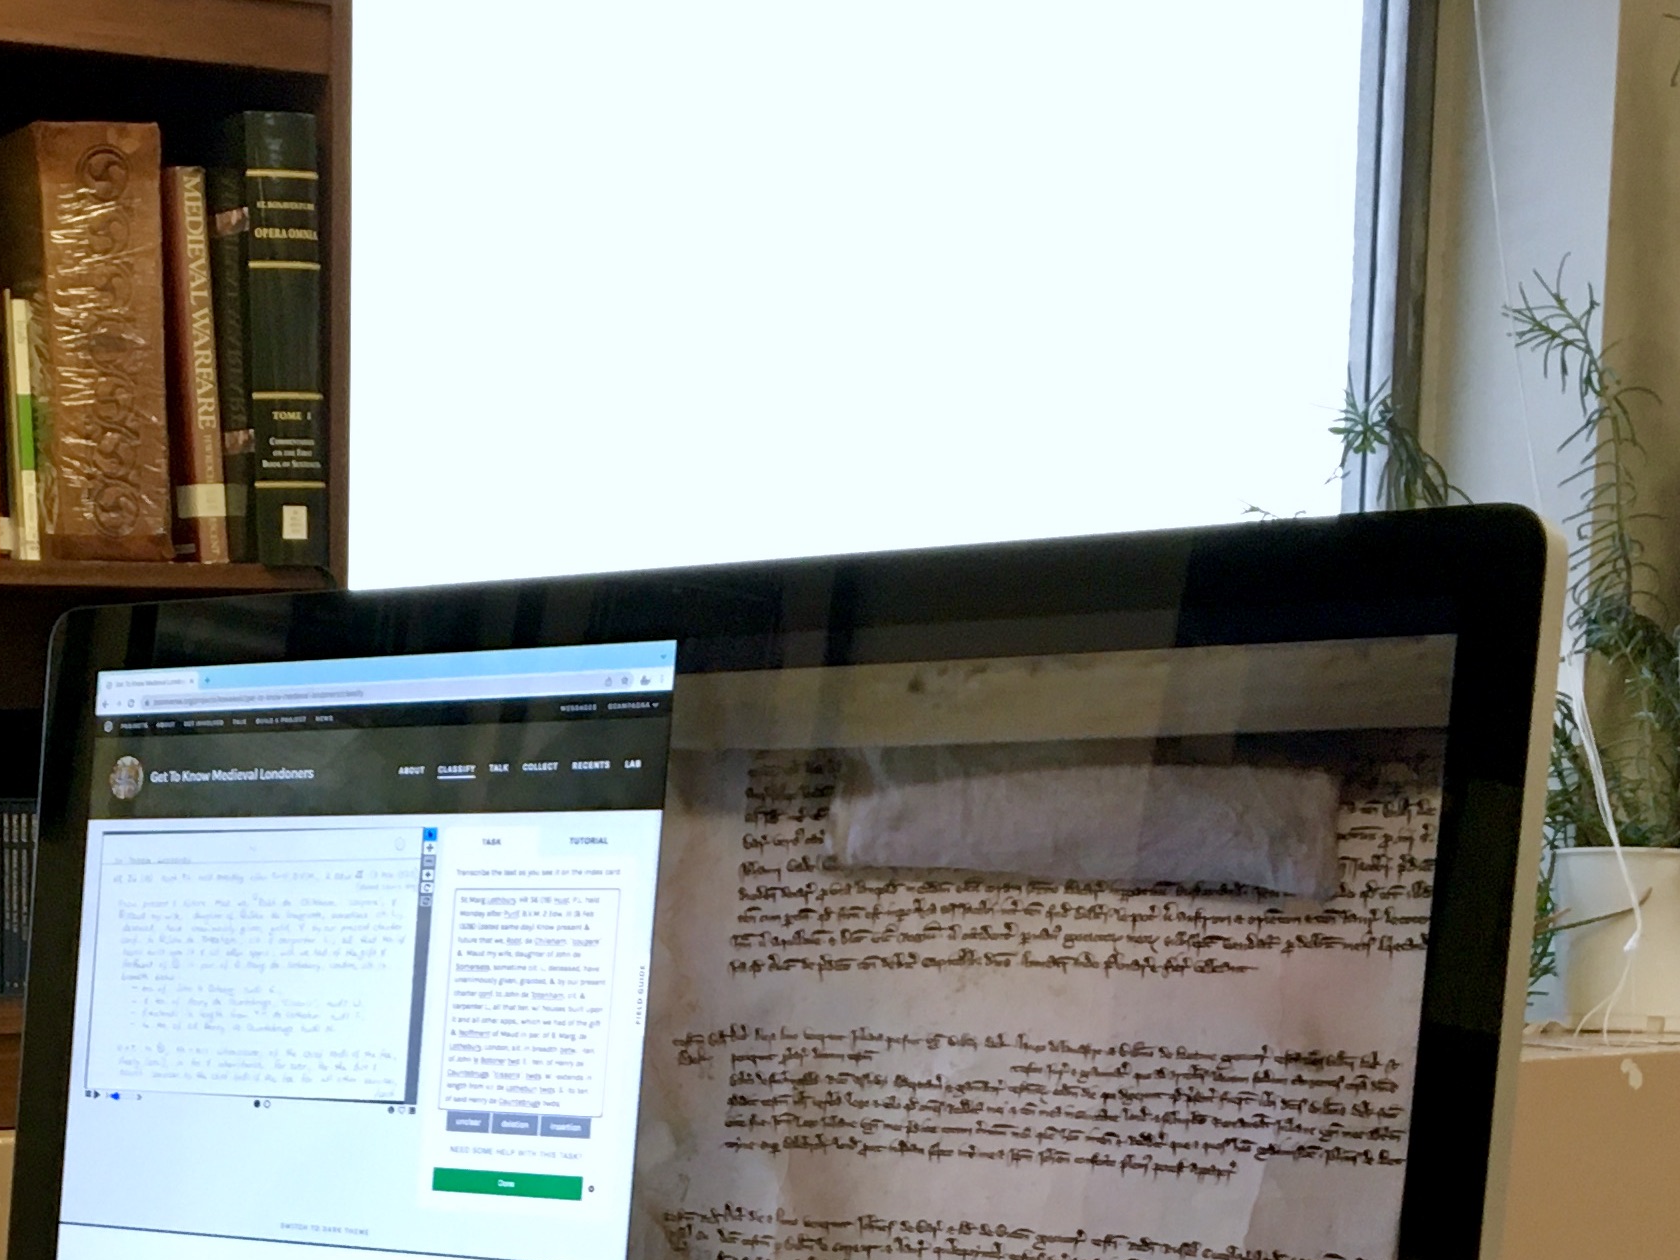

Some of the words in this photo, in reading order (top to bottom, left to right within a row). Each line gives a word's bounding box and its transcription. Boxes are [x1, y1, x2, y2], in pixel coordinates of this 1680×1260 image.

[254, 227, 287, 239] OPERA
[287, 228, 318, 241] OMNIA
[183, 175, 210, 306] MEDIEVAL
[191, 306, 218, 431] WARFARE
[272, 411, 302, 420] TOME
[488, 763, 510, 773] TALK
[521, 761, 559, 772] COLLECT
[571, 760, 611, 770] RECENTS
[624, 758, 642, 769] LAB
[150, 770, 170, 784] Get
[169, 769, 181, 783] To
[181, 768, 210, 783] Know
[211, 766, 258, 782] Medieval
[258, 766, 315, 781] Londoners
[398, 765, 426, 776] ABOUT
[437, 764, 477, 775] CLASSIFY
[482, 838, 501, 846] TASK
[569, 836, 609, 846] TUTORIAL
[456, 868, 490, 877] Transcribe
[527, 869, 539, 878] you
[541, 868, 553, 876] see
[639, 964, 647, 994] GUIDE
[636, 997, 644, 1025] FIELD
[450, 1145, 470, 1154] NEED
[472, 1147, 493, 1155] SOME
[496, 1148, 515, 1156] HELP
[540, 1151, 556, 1159] THIS
